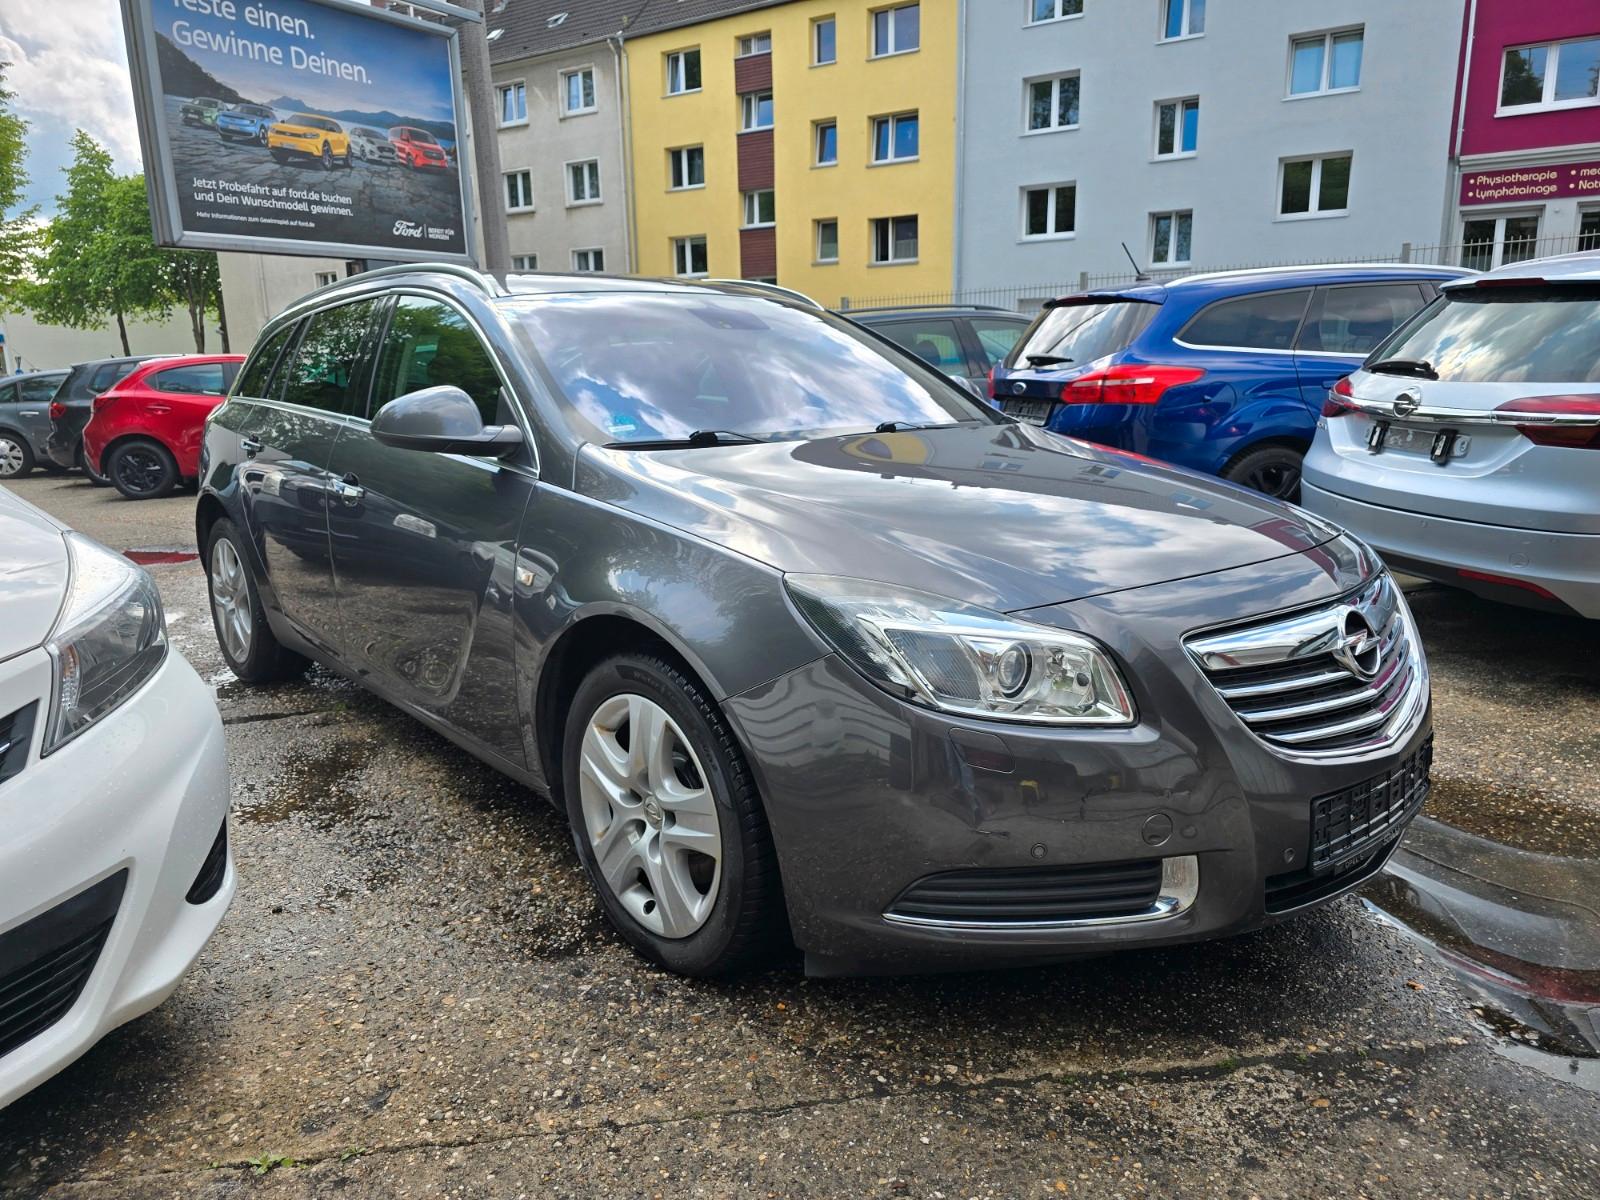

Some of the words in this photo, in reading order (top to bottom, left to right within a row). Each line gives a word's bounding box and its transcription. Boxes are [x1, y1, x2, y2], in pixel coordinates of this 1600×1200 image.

[245, 3, 315, 39] einen.
[172, 20, 283, 65] Gewinne
[291, 45, 372, 85] Deinen.
[1476, 171, 1558, 187] Physiotherapie
[1578, 179, 1600, 190] Nat
[193, 177, 217, 190] Jetzt
[219, 180, 270, 196] Probefahrt
[271, 187, 287, 197] auf
[288, 188, 320, 201] ford.de
[321, 191, 353, 205] buchen
[1475, 184, 1558, 200] Lymphdrainage
[194, 191, 214, 202] und
[216, 192, 240, 205] Dein
[240, 195, 309, 212] Wunschmodell
[310, 204, 354, 217] gewinnen.
[392, 219, 423, 238] Ford
